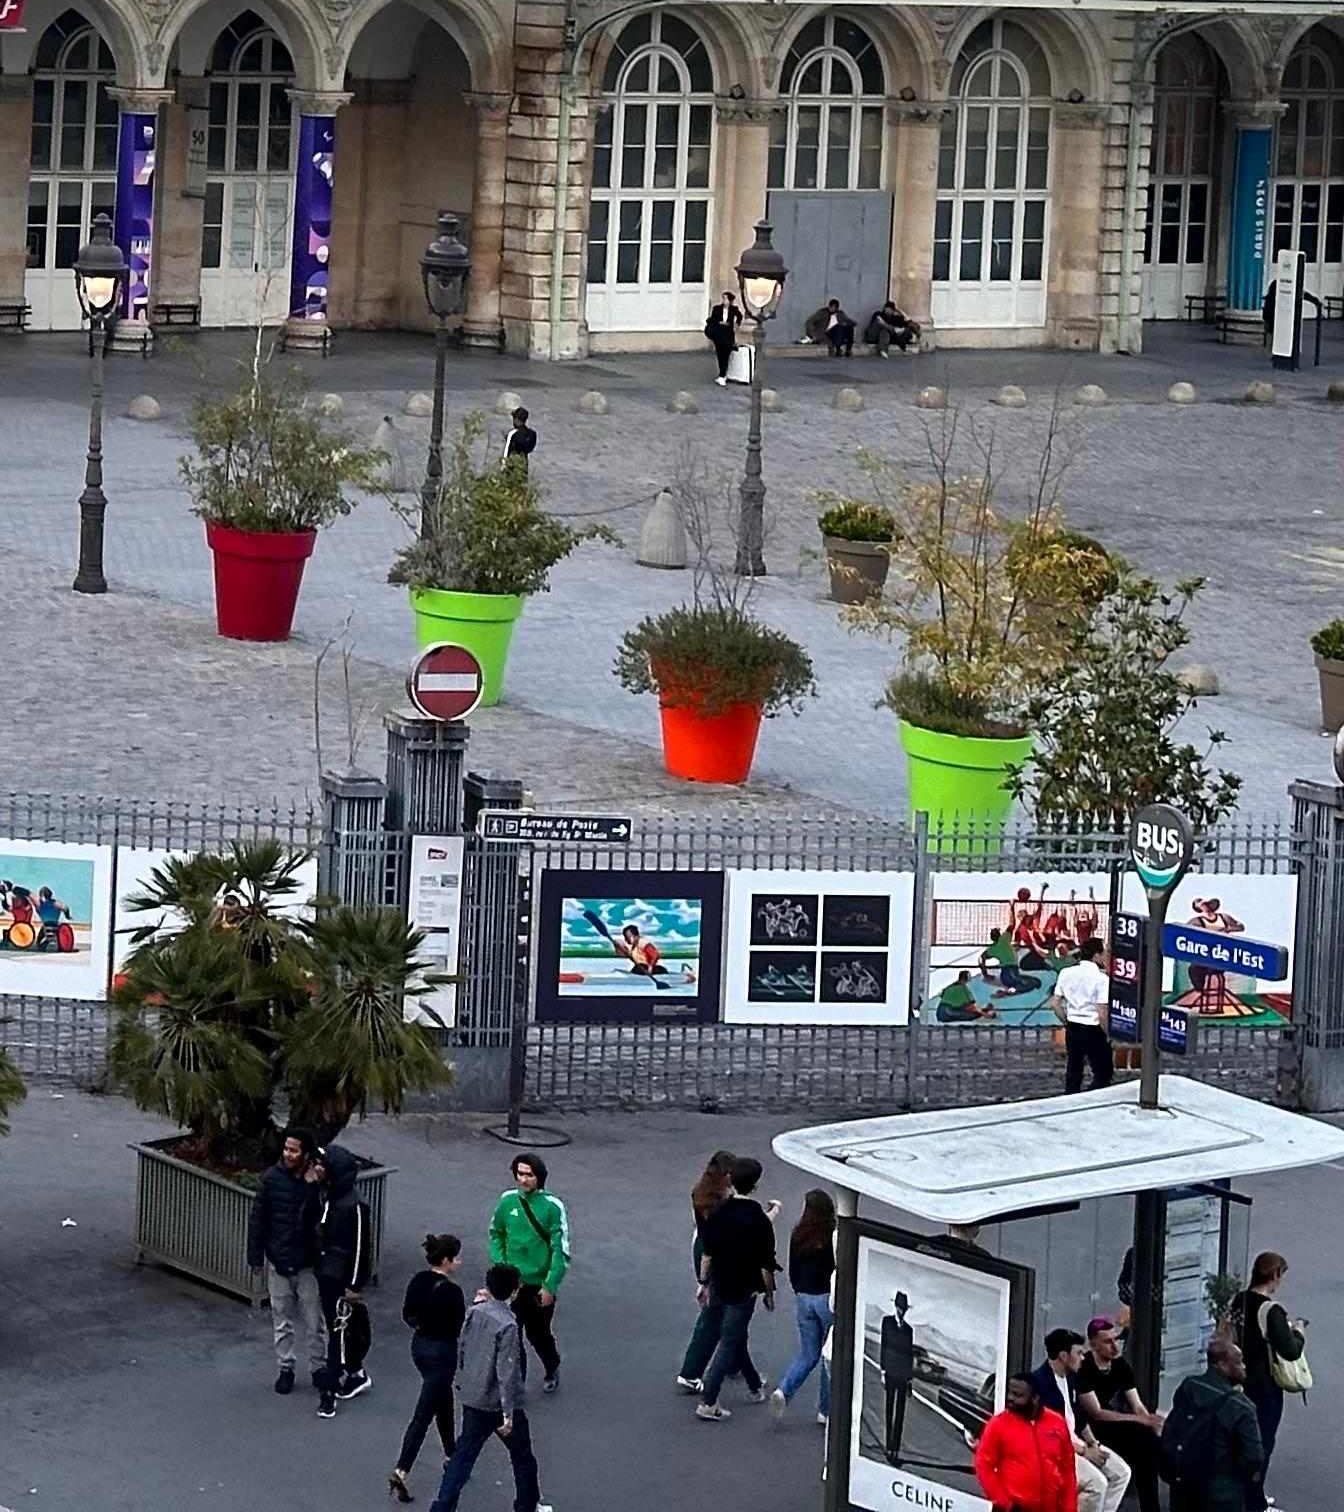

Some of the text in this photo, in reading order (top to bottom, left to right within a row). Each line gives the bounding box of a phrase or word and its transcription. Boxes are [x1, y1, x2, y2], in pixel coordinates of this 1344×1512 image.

[1254, 180, 1265, 259] PARIS 2024
[1137, 821, 1179, 854] BUS
[1116, 917, 1138, 938] 38
[1114, 958, 1137, 979] 39
[1175, 936, 1265, 971] Gare de l'Est
[892, 1481, 955, 1512] CELINE
